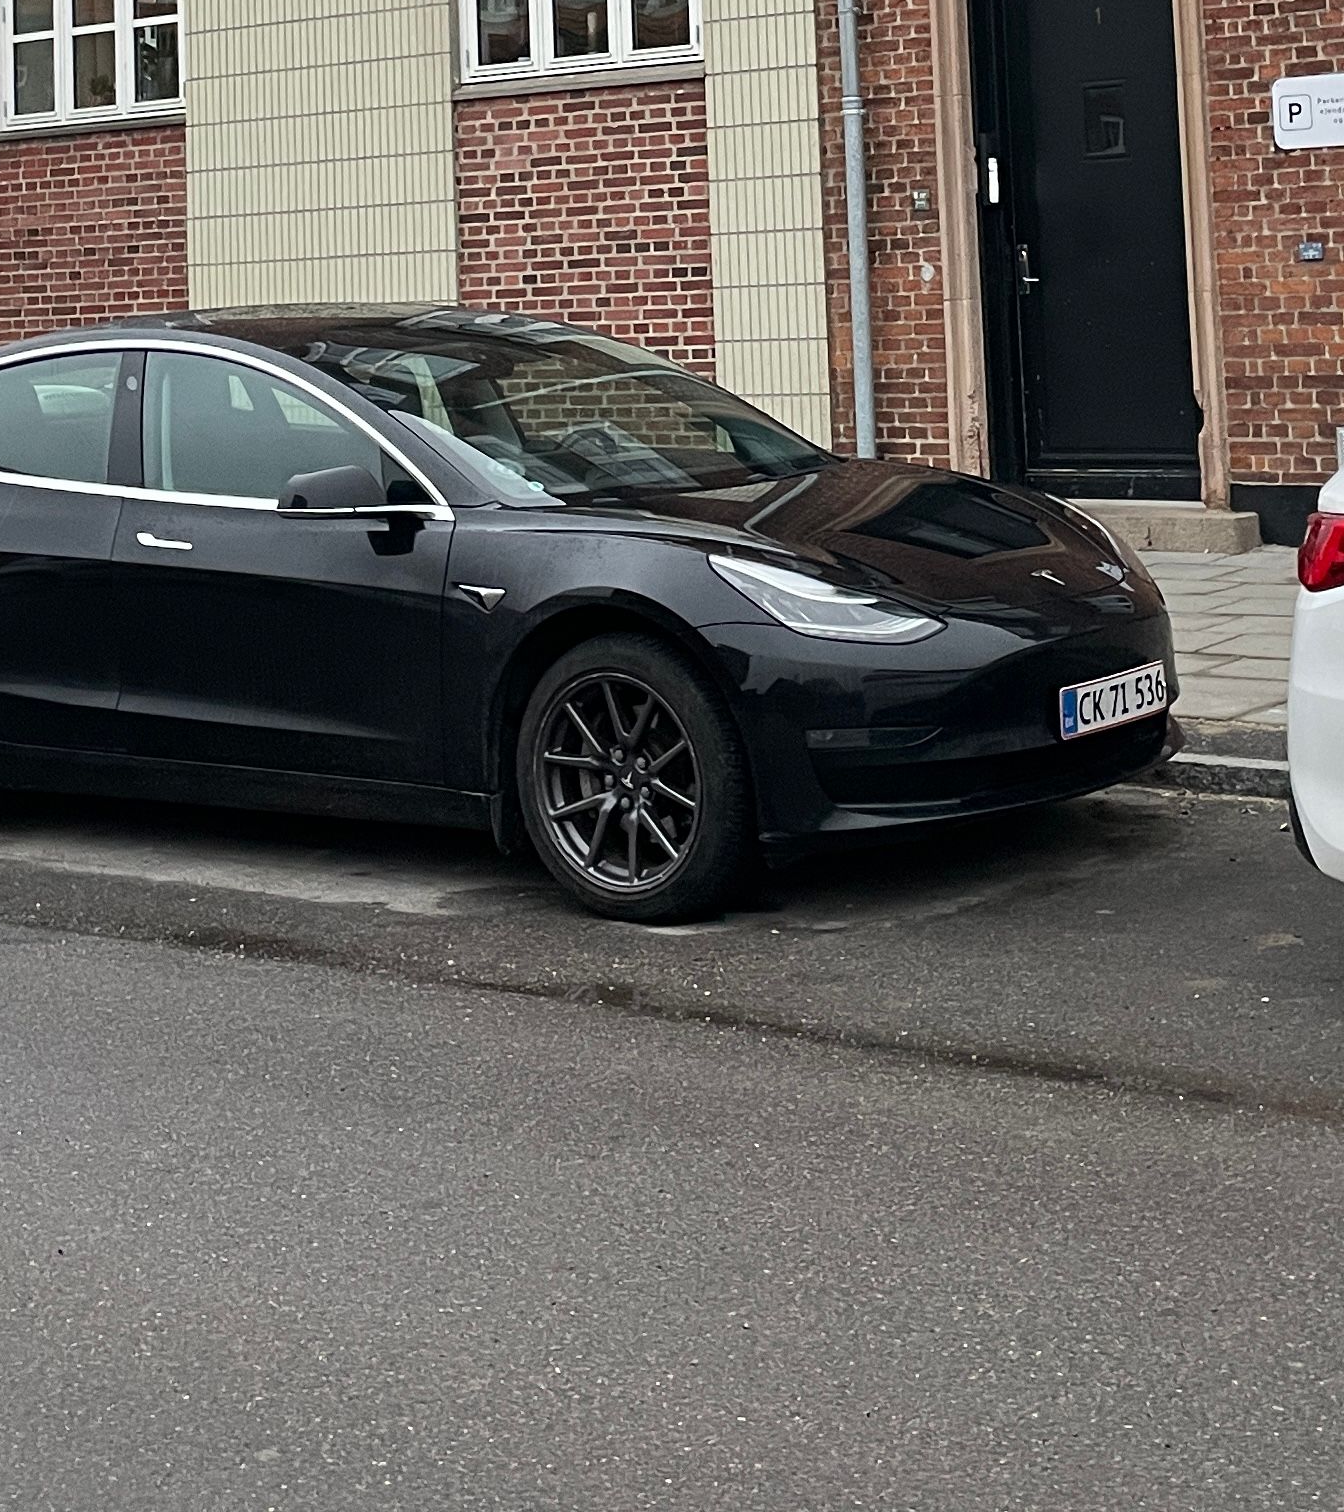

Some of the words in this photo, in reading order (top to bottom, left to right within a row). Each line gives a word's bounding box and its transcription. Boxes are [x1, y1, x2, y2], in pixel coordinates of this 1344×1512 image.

[1288, 102, 1302, 123] P
[1079, 689, 1106, 725] CK
[1110, 682, 1129, 718] 71
[1135, 670, 1165, 710] 536
